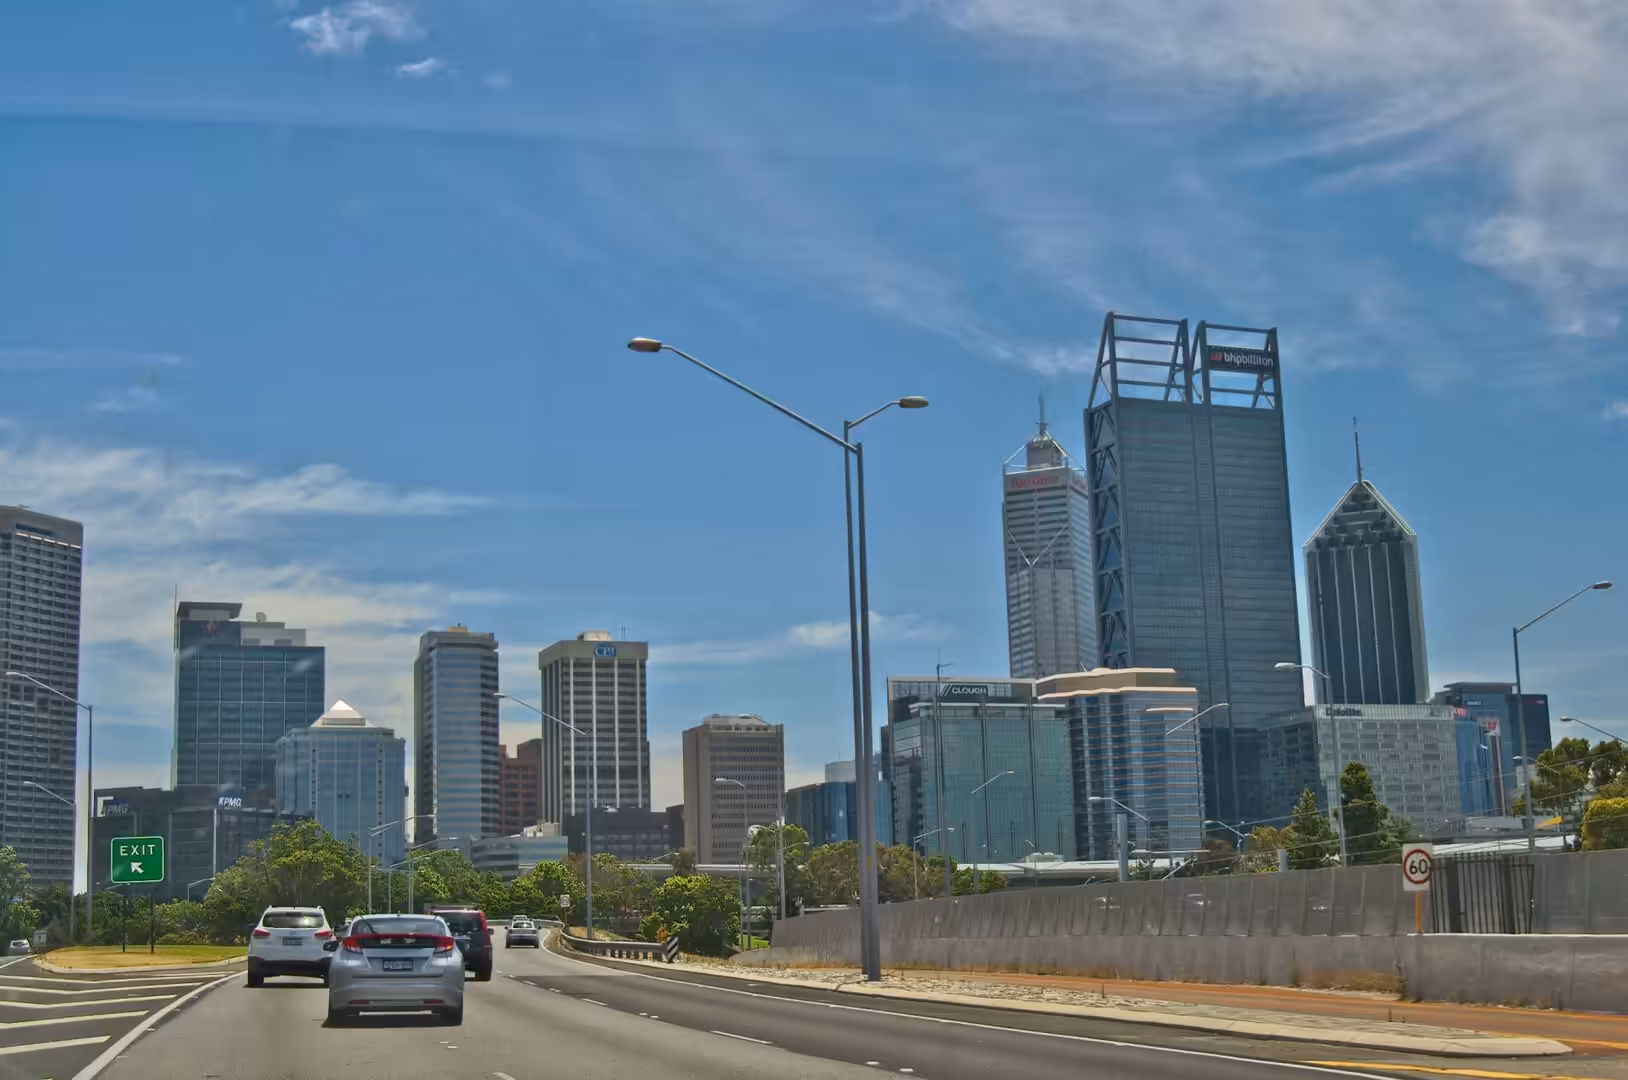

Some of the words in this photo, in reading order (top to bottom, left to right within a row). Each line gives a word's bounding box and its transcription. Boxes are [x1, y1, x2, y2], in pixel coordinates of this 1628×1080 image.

[1223, 352, 1274, 366] bhpbilliton
[951, 686, 987, 695] CLOUGH
[218, 797, 242, 807] KPMG
[119, 844, 156, 856] EXIT
[1409, 858, 1428, 874] 60
